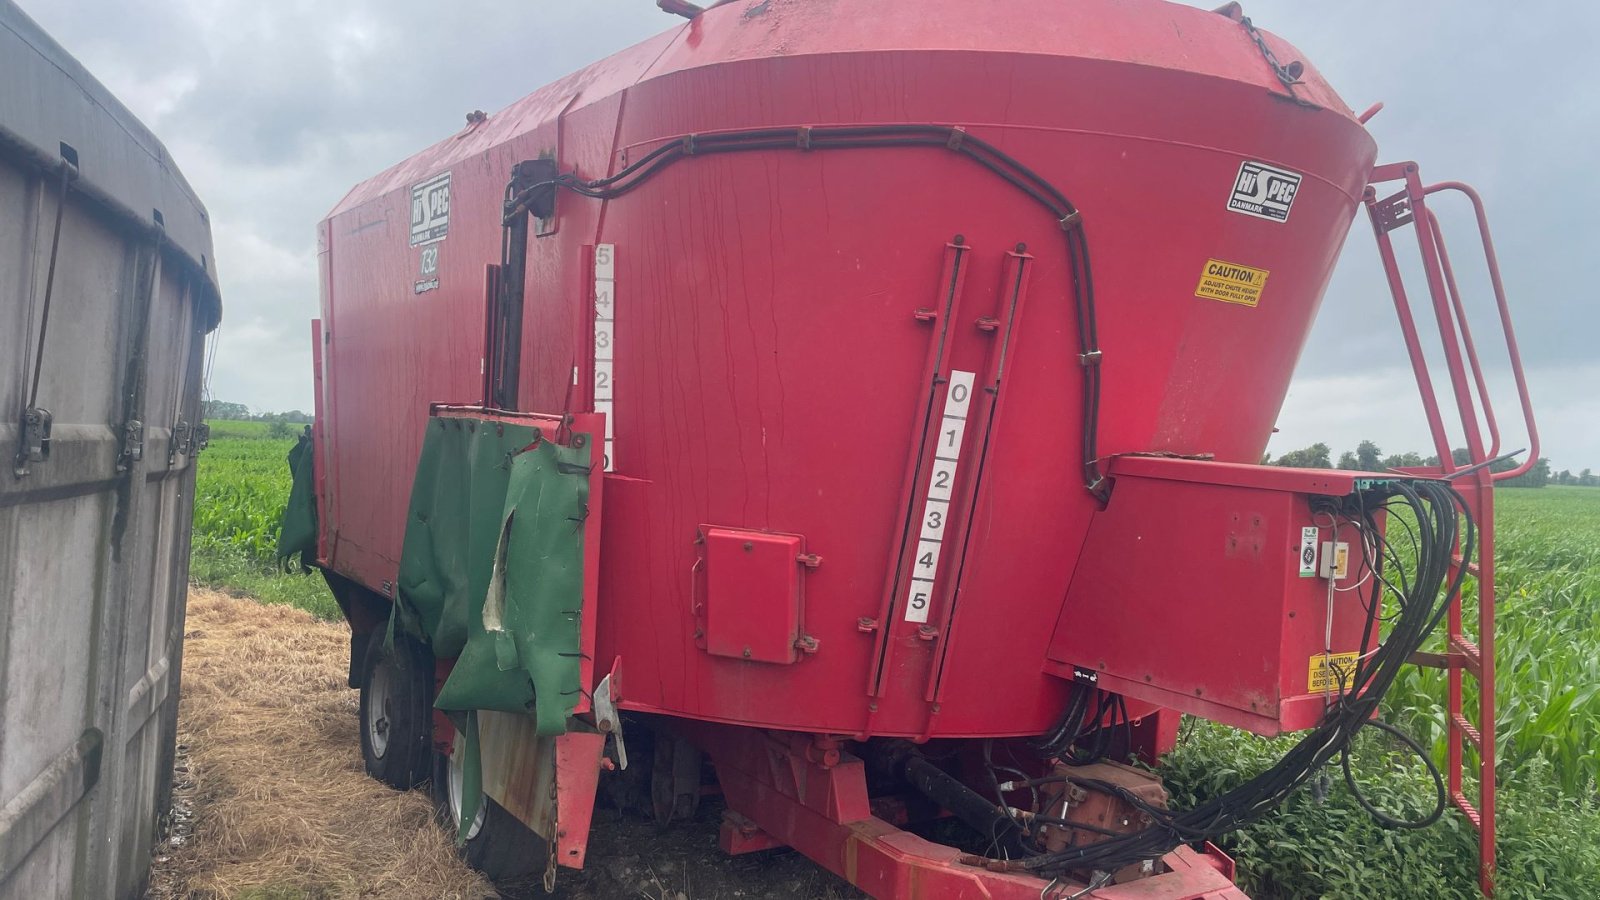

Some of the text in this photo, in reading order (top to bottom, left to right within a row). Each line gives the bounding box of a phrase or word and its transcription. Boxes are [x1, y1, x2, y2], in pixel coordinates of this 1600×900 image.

[1231, 199, 1264, 213] DANMARK
[598, 248, 610, 265] 5
[1208, 264, 1254, 282] CAUTION
[1204, 280, 1225, 288] ADJUST
[1225, 284, 1241, 292] CHUTE
[597, 291, 610, 308] 4
[597, 331, 609, 348] 3
[597, 371, 608, 388] 2
[951, 384, 968, 403] 0
[946, 429, 956, 447] 1
[934, 471, 950, 489] 2
[927, 511, 942, 529] 3
[919, 552, 933, 569] 4
[912, 593, 926, 609] 5
[1330, 656, 1353, 665] AUTION
